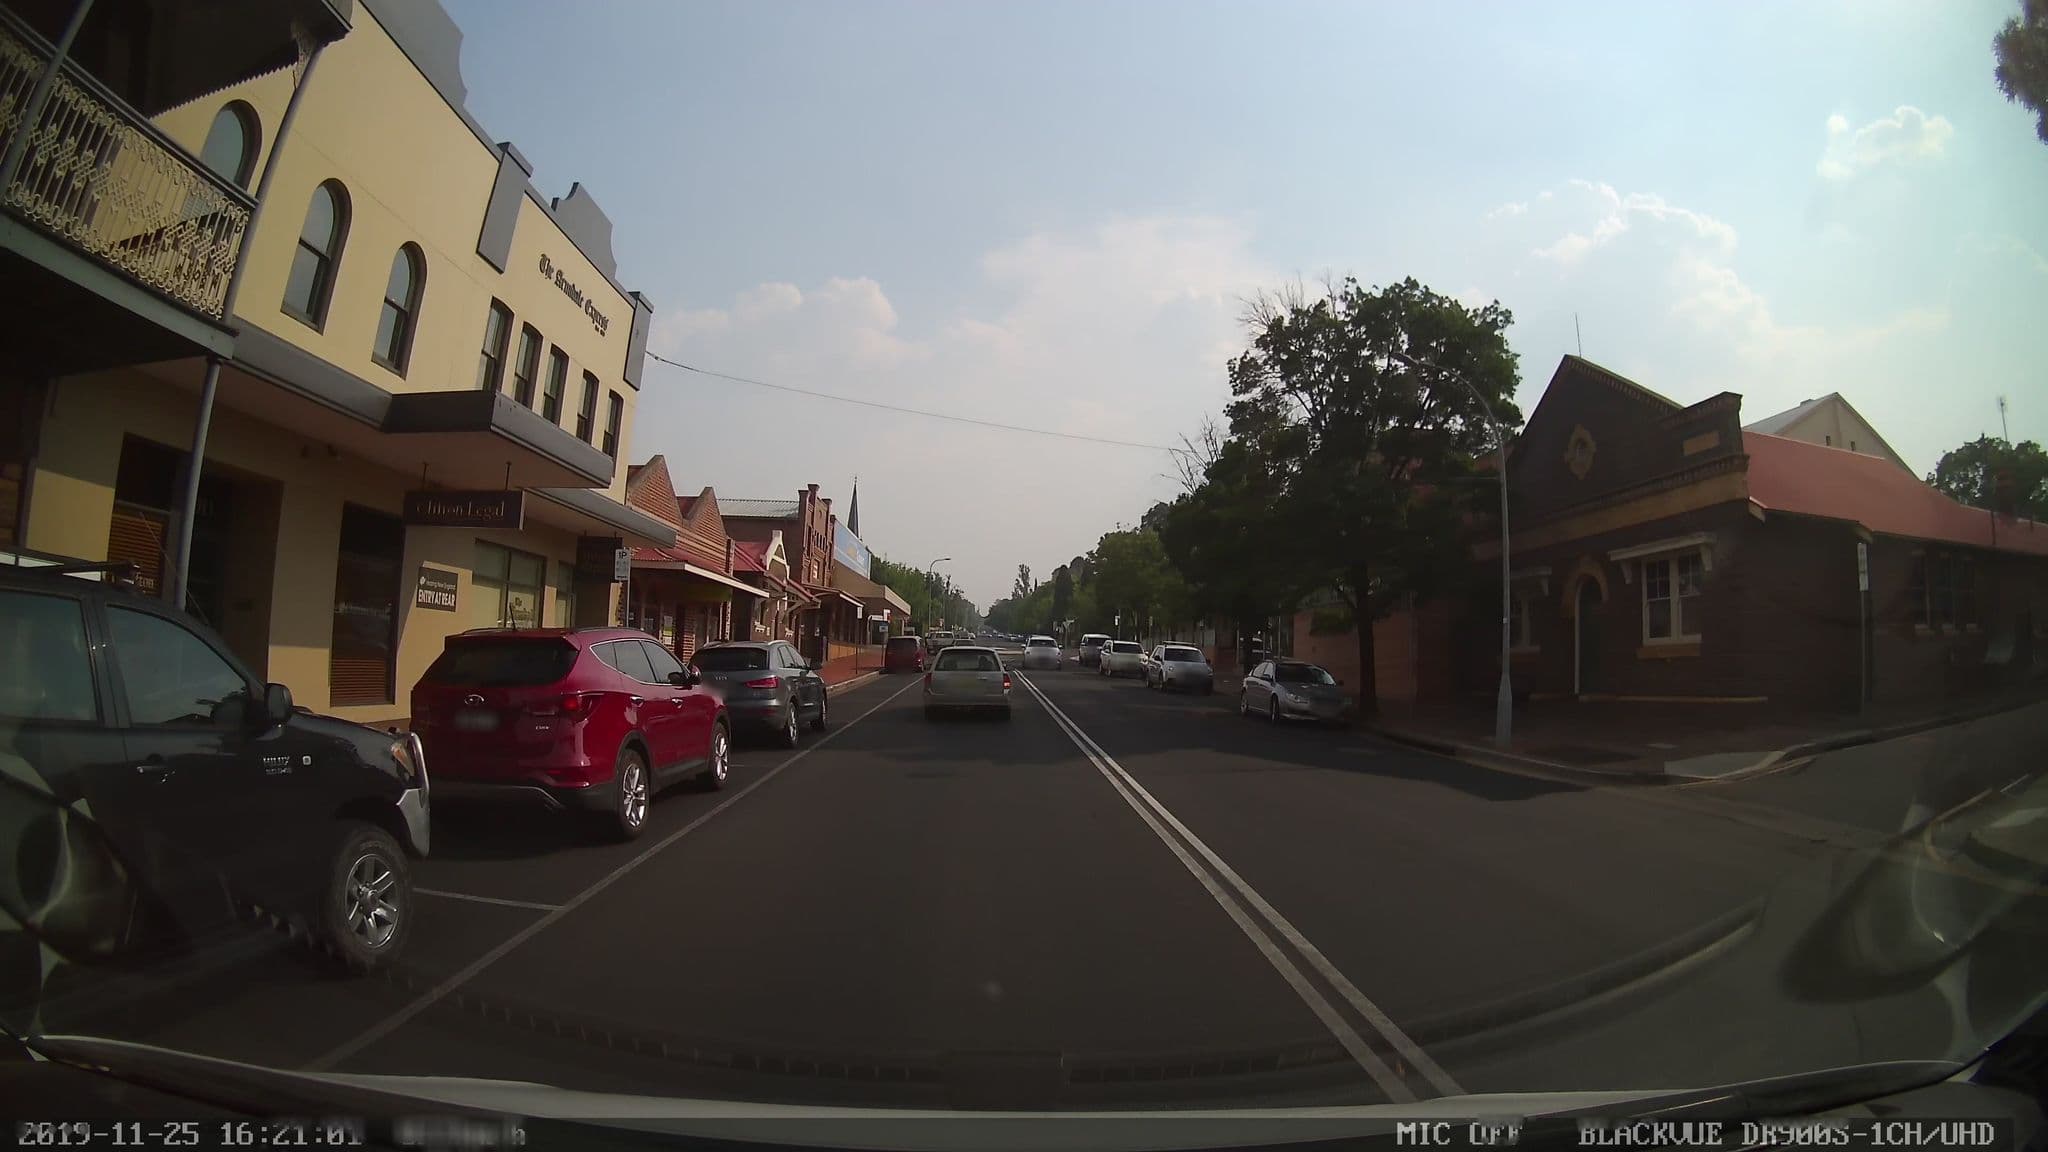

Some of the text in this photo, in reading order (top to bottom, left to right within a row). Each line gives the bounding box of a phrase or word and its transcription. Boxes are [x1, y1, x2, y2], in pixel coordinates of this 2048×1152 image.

[418, 589, 456, 607] ENTRY AT REAR
